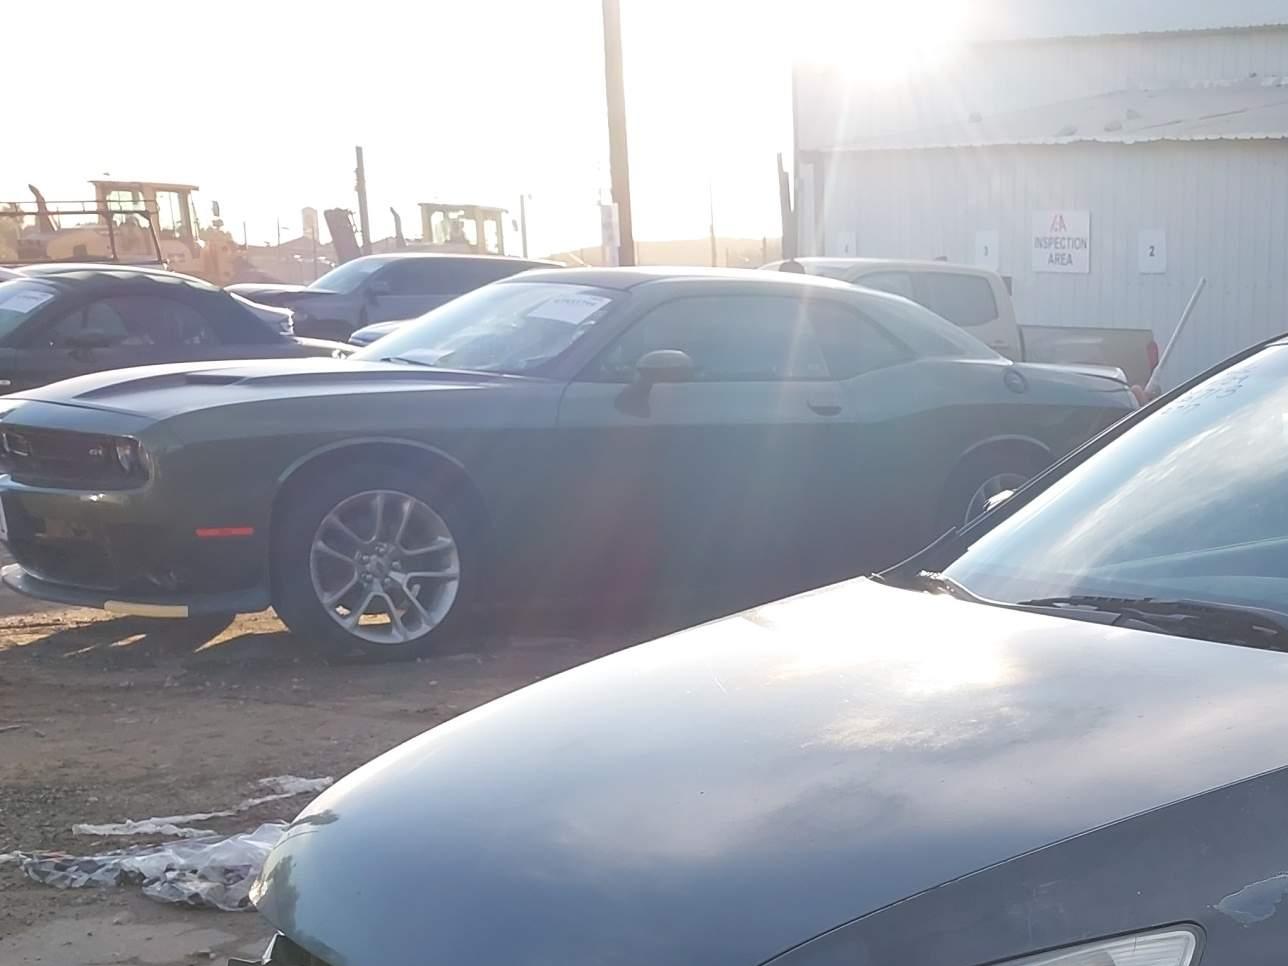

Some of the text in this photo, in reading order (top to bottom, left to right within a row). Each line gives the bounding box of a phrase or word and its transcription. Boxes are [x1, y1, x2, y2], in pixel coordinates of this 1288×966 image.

[1034, 236, 1087, 250] INSPECTION
[1149, 245, 1155, 257] 2
[1048, 252, 1073, 266] AREA
